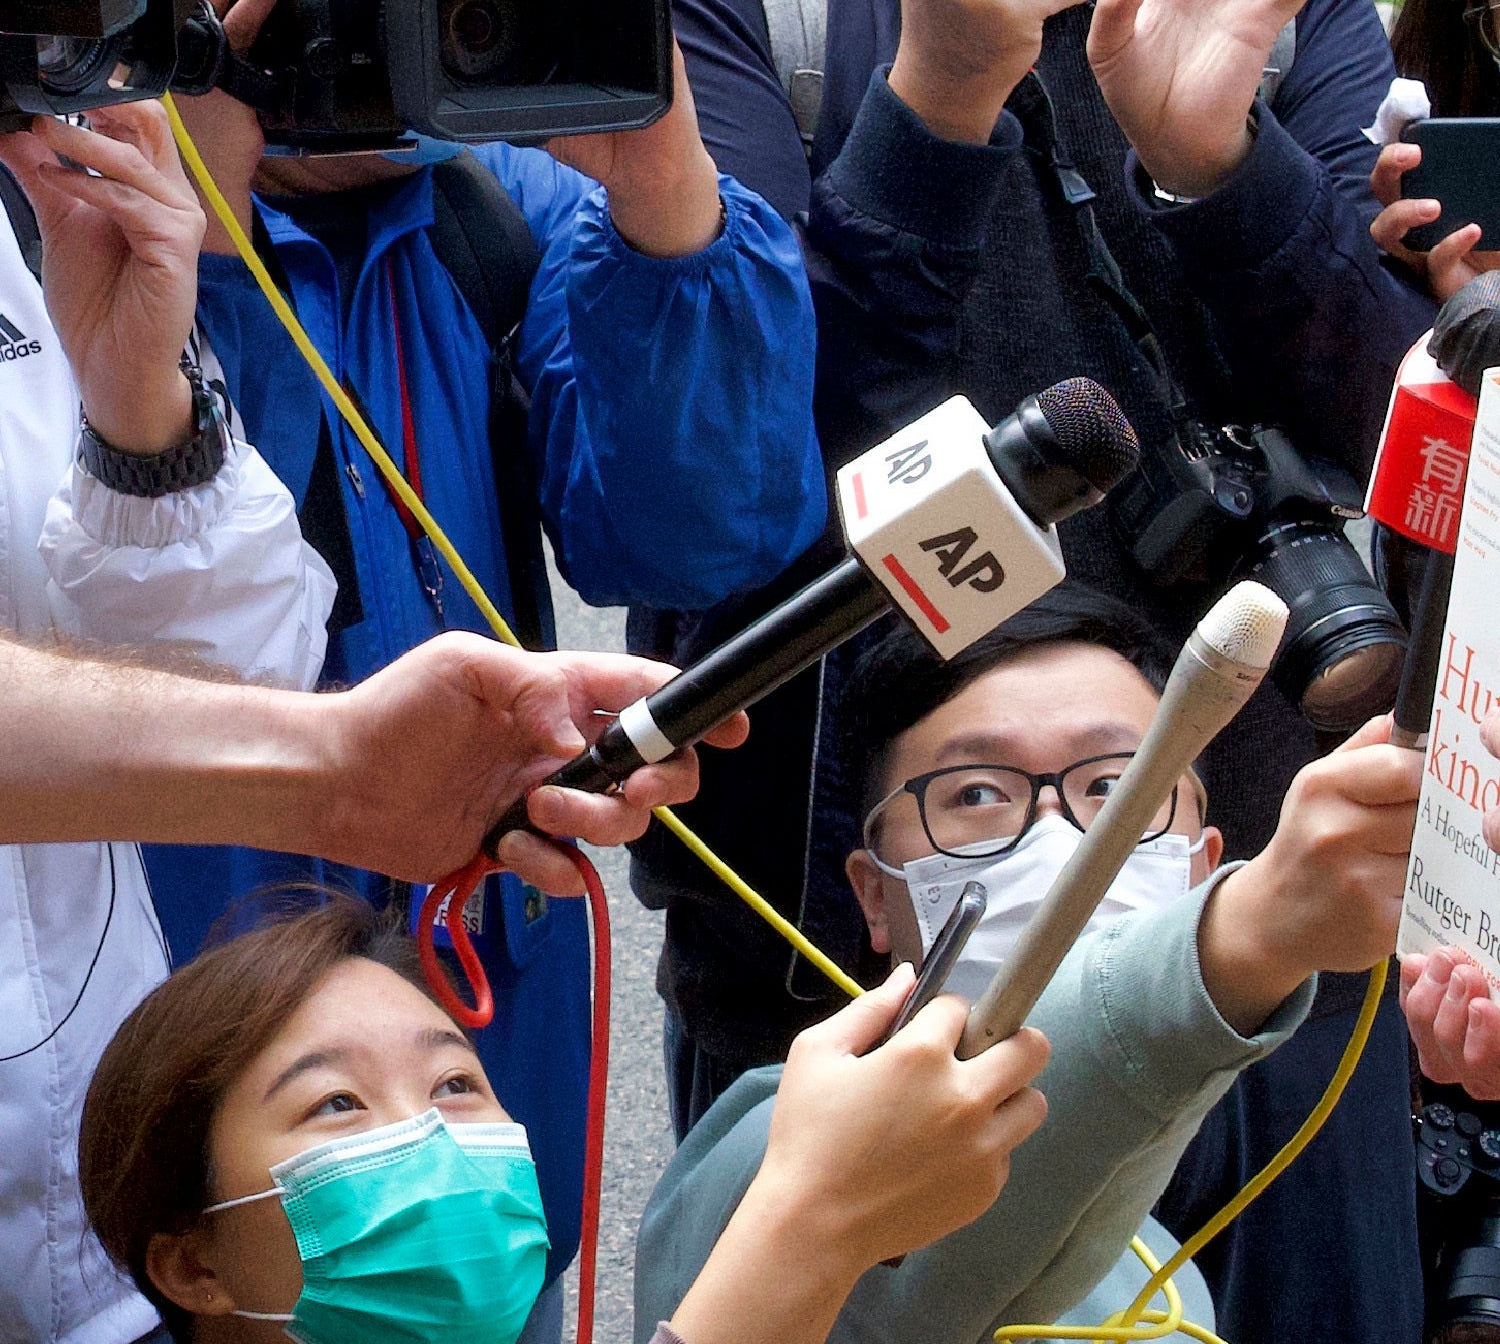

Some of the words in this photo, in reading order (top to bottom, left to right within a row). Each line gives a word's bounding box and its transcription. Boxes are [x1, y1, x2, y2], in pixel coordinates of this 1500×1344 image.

[884, 438, 932, 485] AP
[917, 525, 1005, 593] AP
[1421, 796, 1431, 825] A
[1435, 804, 1490, 869] Hopeful
[1409, 854, 1472, 935] Rutger
